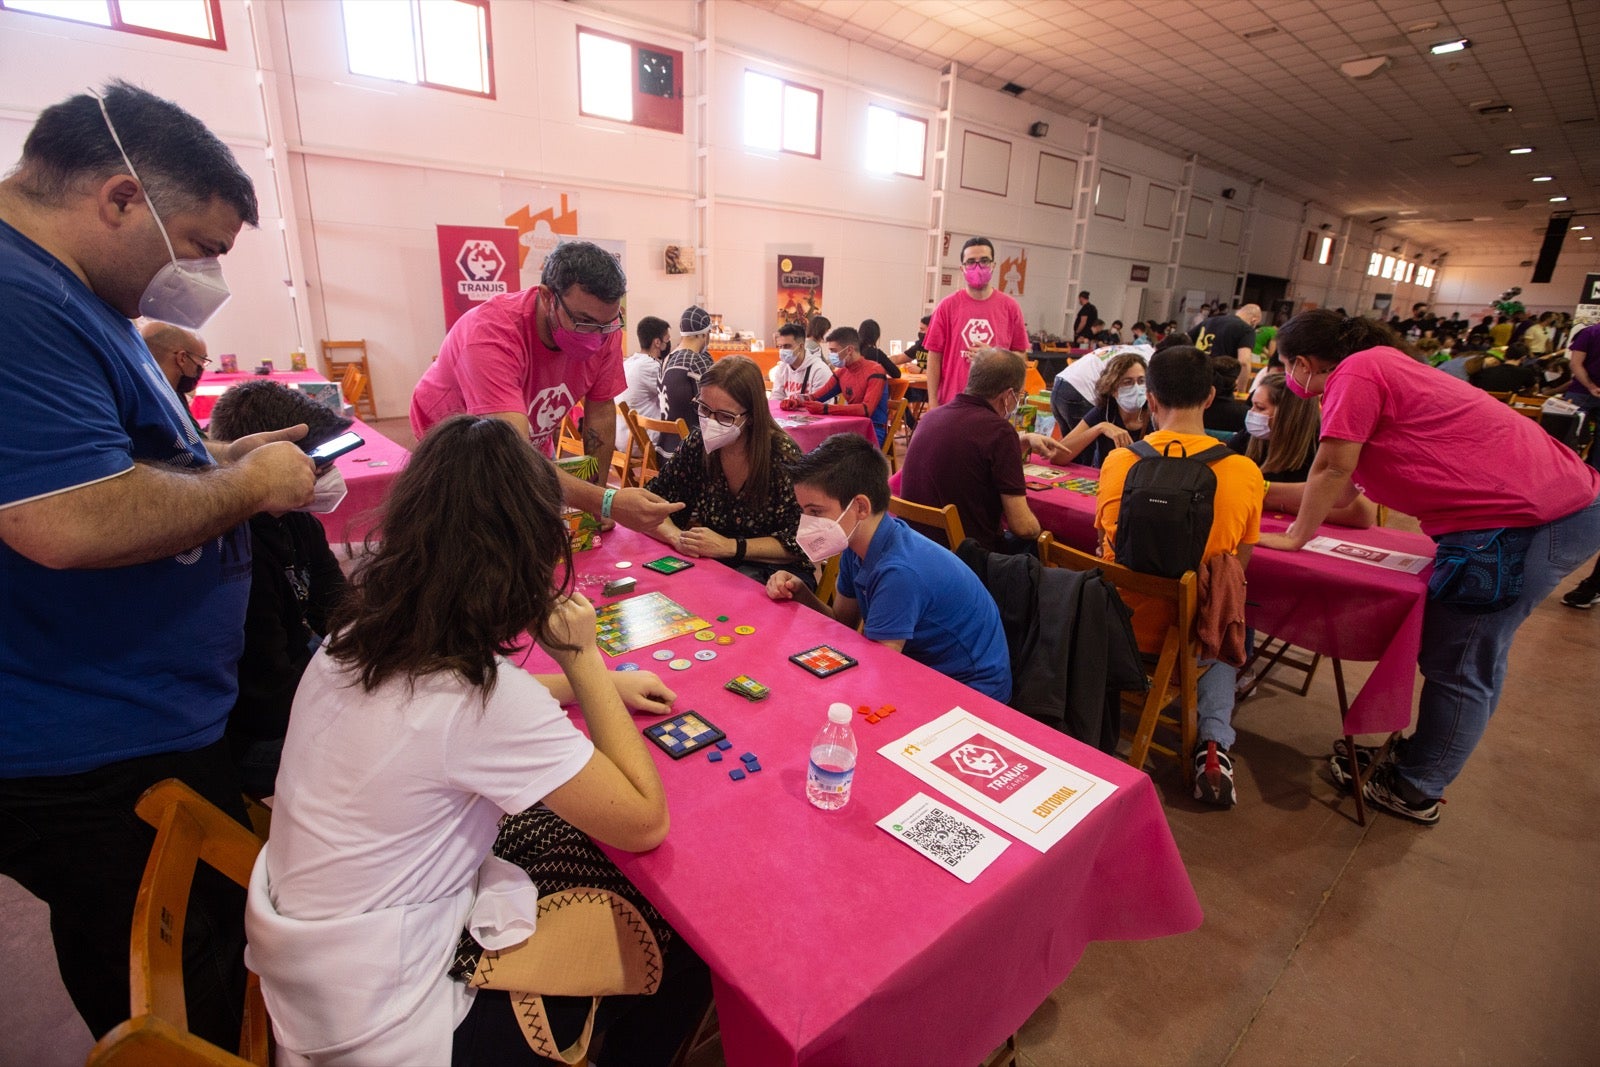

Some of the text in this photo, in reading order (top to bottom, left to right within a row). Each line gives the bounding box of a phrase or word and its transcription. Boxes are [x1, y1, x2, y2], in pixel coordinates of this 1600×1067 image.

[460, 283, 505, 292] TRANJIS
[987, 763, 1028, 790] TRANJIS
[1006, 774, 1029, 791] GAMES
[1032, 786, 1077, 818] EDITORIAL
